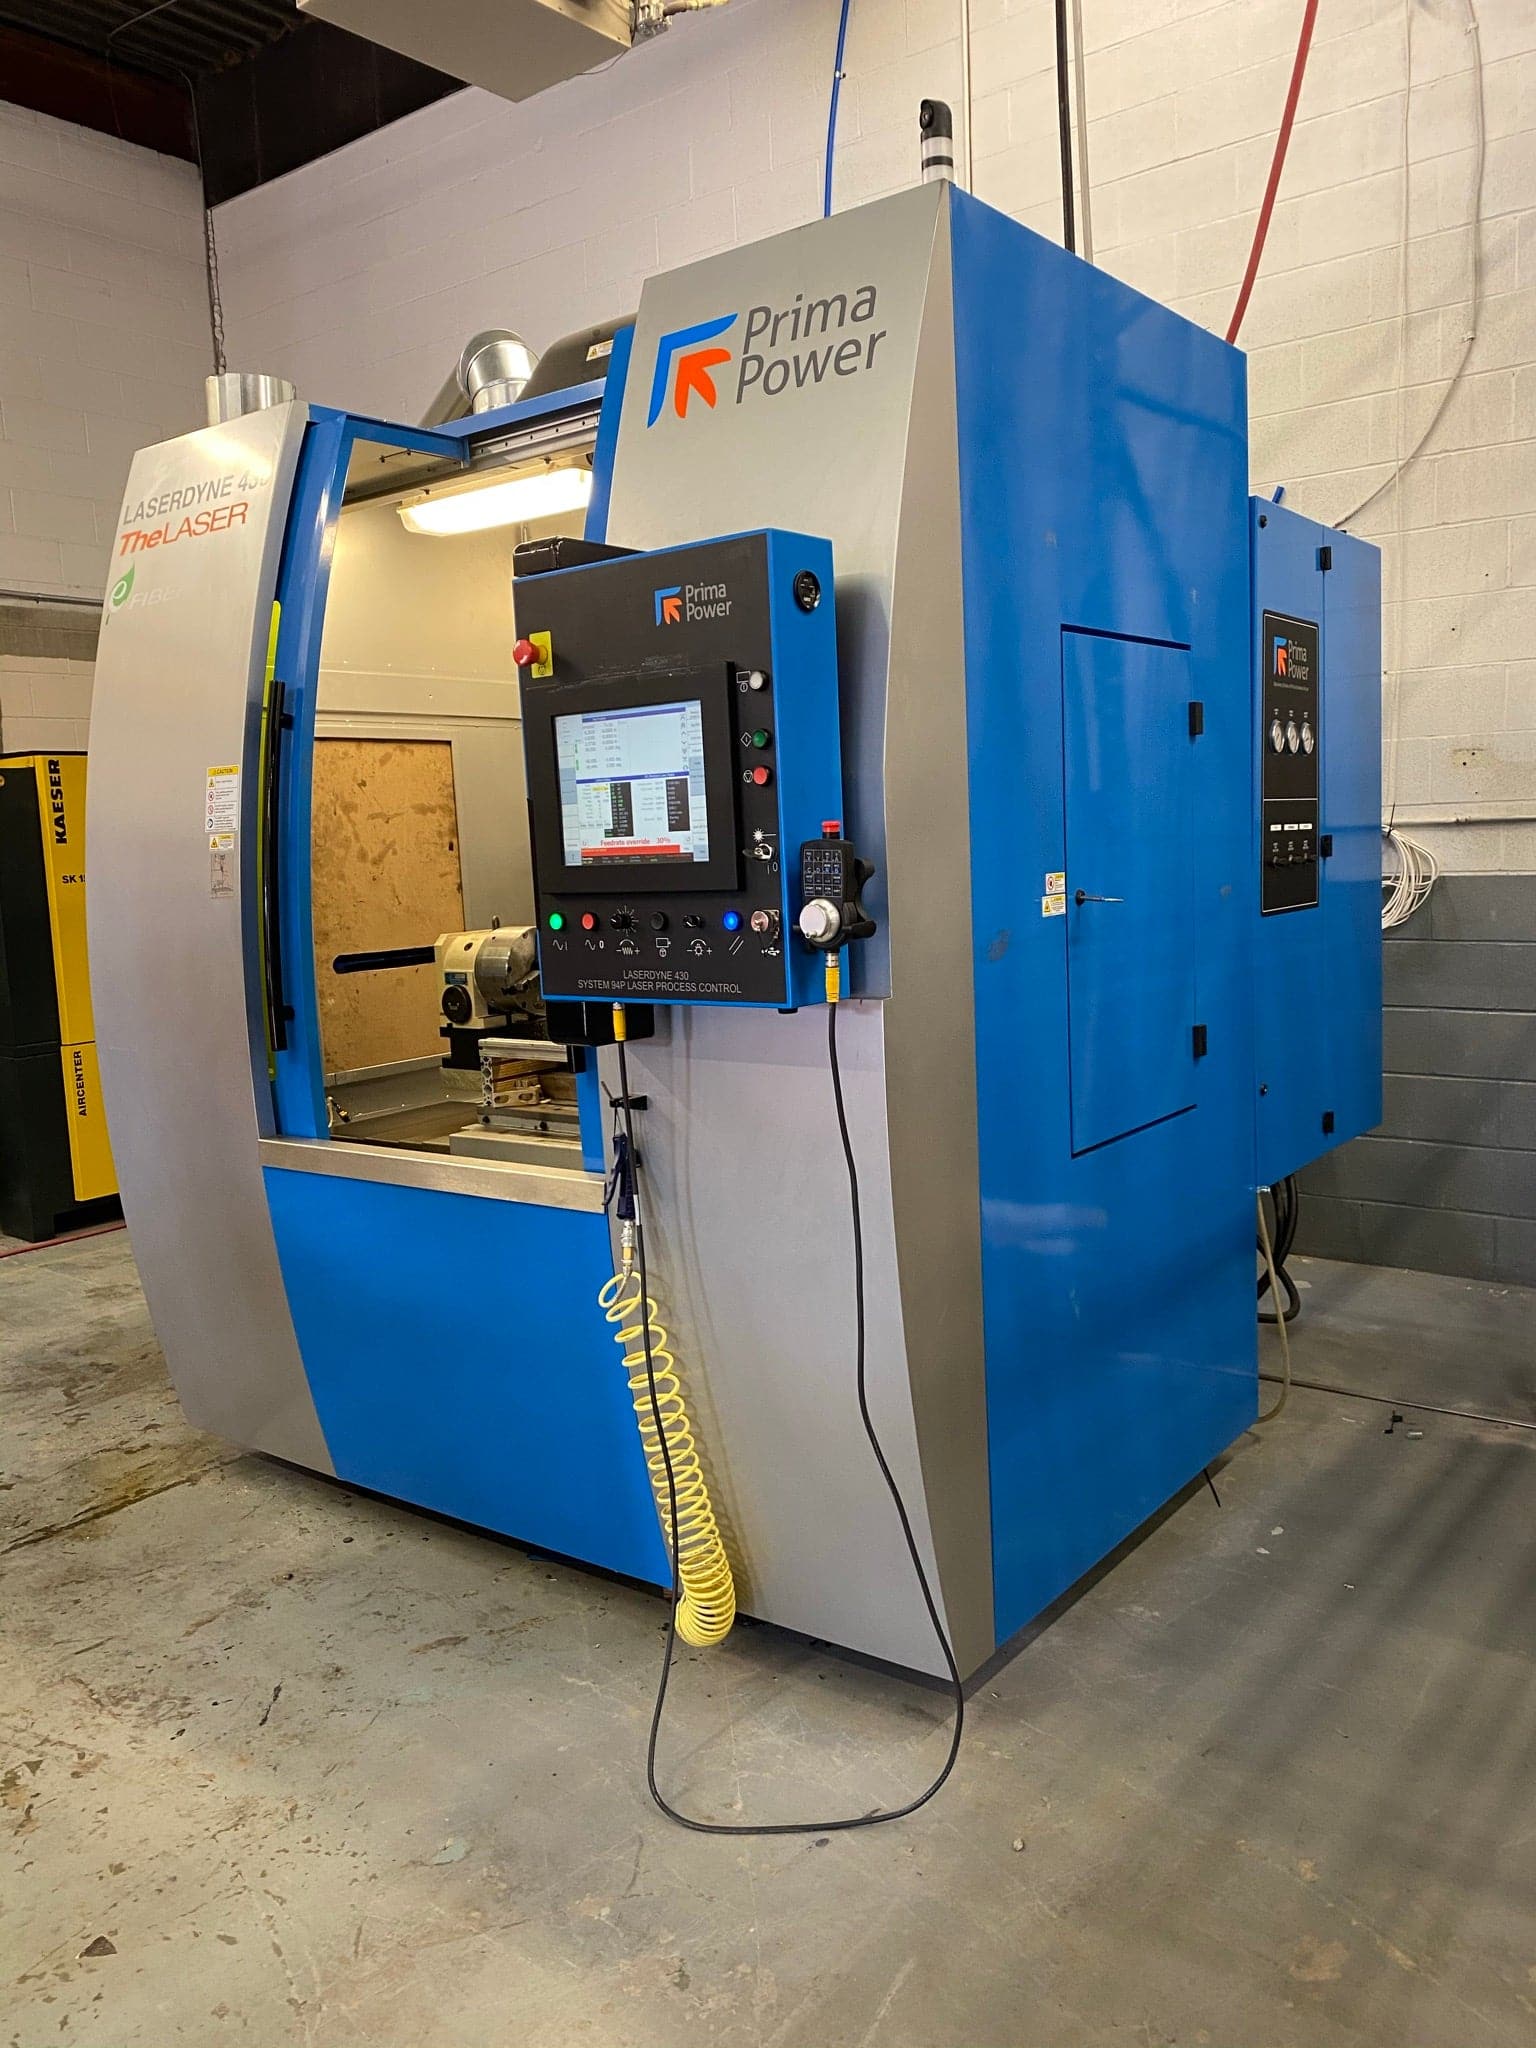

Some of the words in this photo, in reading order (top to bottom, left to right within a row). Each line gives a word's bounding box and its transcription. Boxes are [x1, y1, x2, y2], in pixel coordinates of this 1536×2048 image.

[742, 285, 877, 354] Prima
[736, 330, 887, 404] Power
[123, 474, 234, 525] LASERDYNE
[119, 502, 249, 556] TheLASER
[685, 582, 727, 603] Prima
[686, 601, 732, 622] Power
[1288, 639, 1307, 662] Prima
[1288, 659, 1309, 680] Power
[48, 759, 68, 845] KAESER
[62, 874, 77, 884] SK
[577, 979, 610, 989] SYSTEM
[611, 980, 626, 990] 94P
[627, 981, 654, 991] LASER
[656, 982, 697, 992] PROCESS
[698, 983, 742, 994] CONTROL
[623, 970, 673, 980] LASERDYNE
[674, 971, 689, 981] 430
[74, 1050, 87, 1117] AIRCENTER
